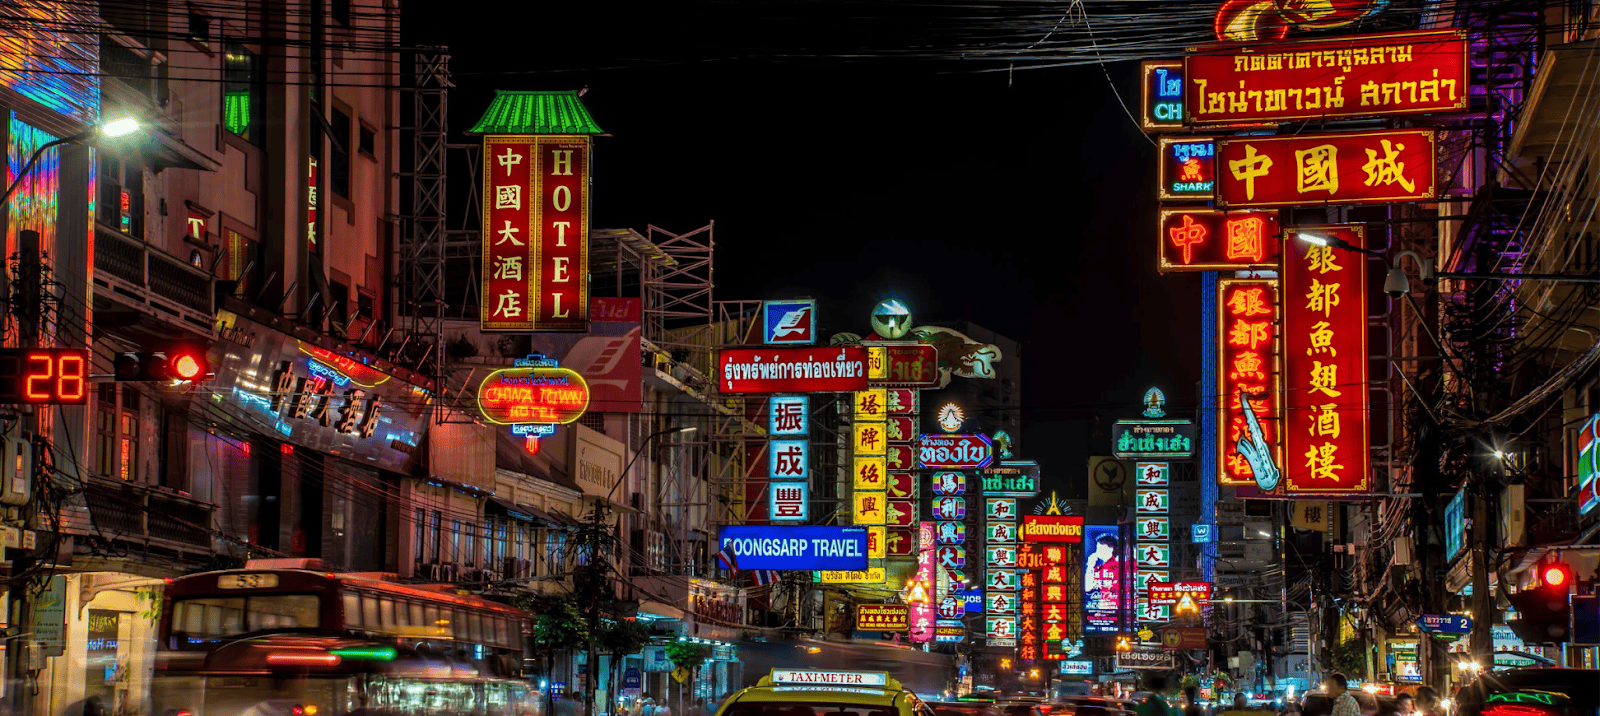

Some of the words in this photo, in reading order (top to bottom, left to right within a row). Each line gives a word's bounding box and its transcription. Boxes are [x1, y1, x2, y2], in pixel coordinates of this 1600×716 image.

[1193, 76, 1345, 115] ไชน่าทาวน์
[1360, 69, 1458, 107] สกาล่า
[1228, 139, 1416, 201] 中國城
[493, 148, 525, 318] 中國大酒店
[551, 150, 574, 318] HOTEL
[1169, 215, 1264, 264] 中國
[26, 355, 85, 399] 28
[724, 349, 863, 390] รุ่งทรัพย์การท่องเที่ยว
[1304, 243, 1344, 482] 銀都魚翅酒樓
[486, 388, 533, 403] CHINA
[540, 388, 583, 405] TOWN
[510, 405, 557, 419] HOTEL
[775, 402, 803, 517] 振成豐
[920, 439, 984, 463] ทองใบ
[812, 539, 863, 557] TRAVEL
[1460, 618, 1468, 628] 2
[790, 672, 863, 684] TAXI-METER
